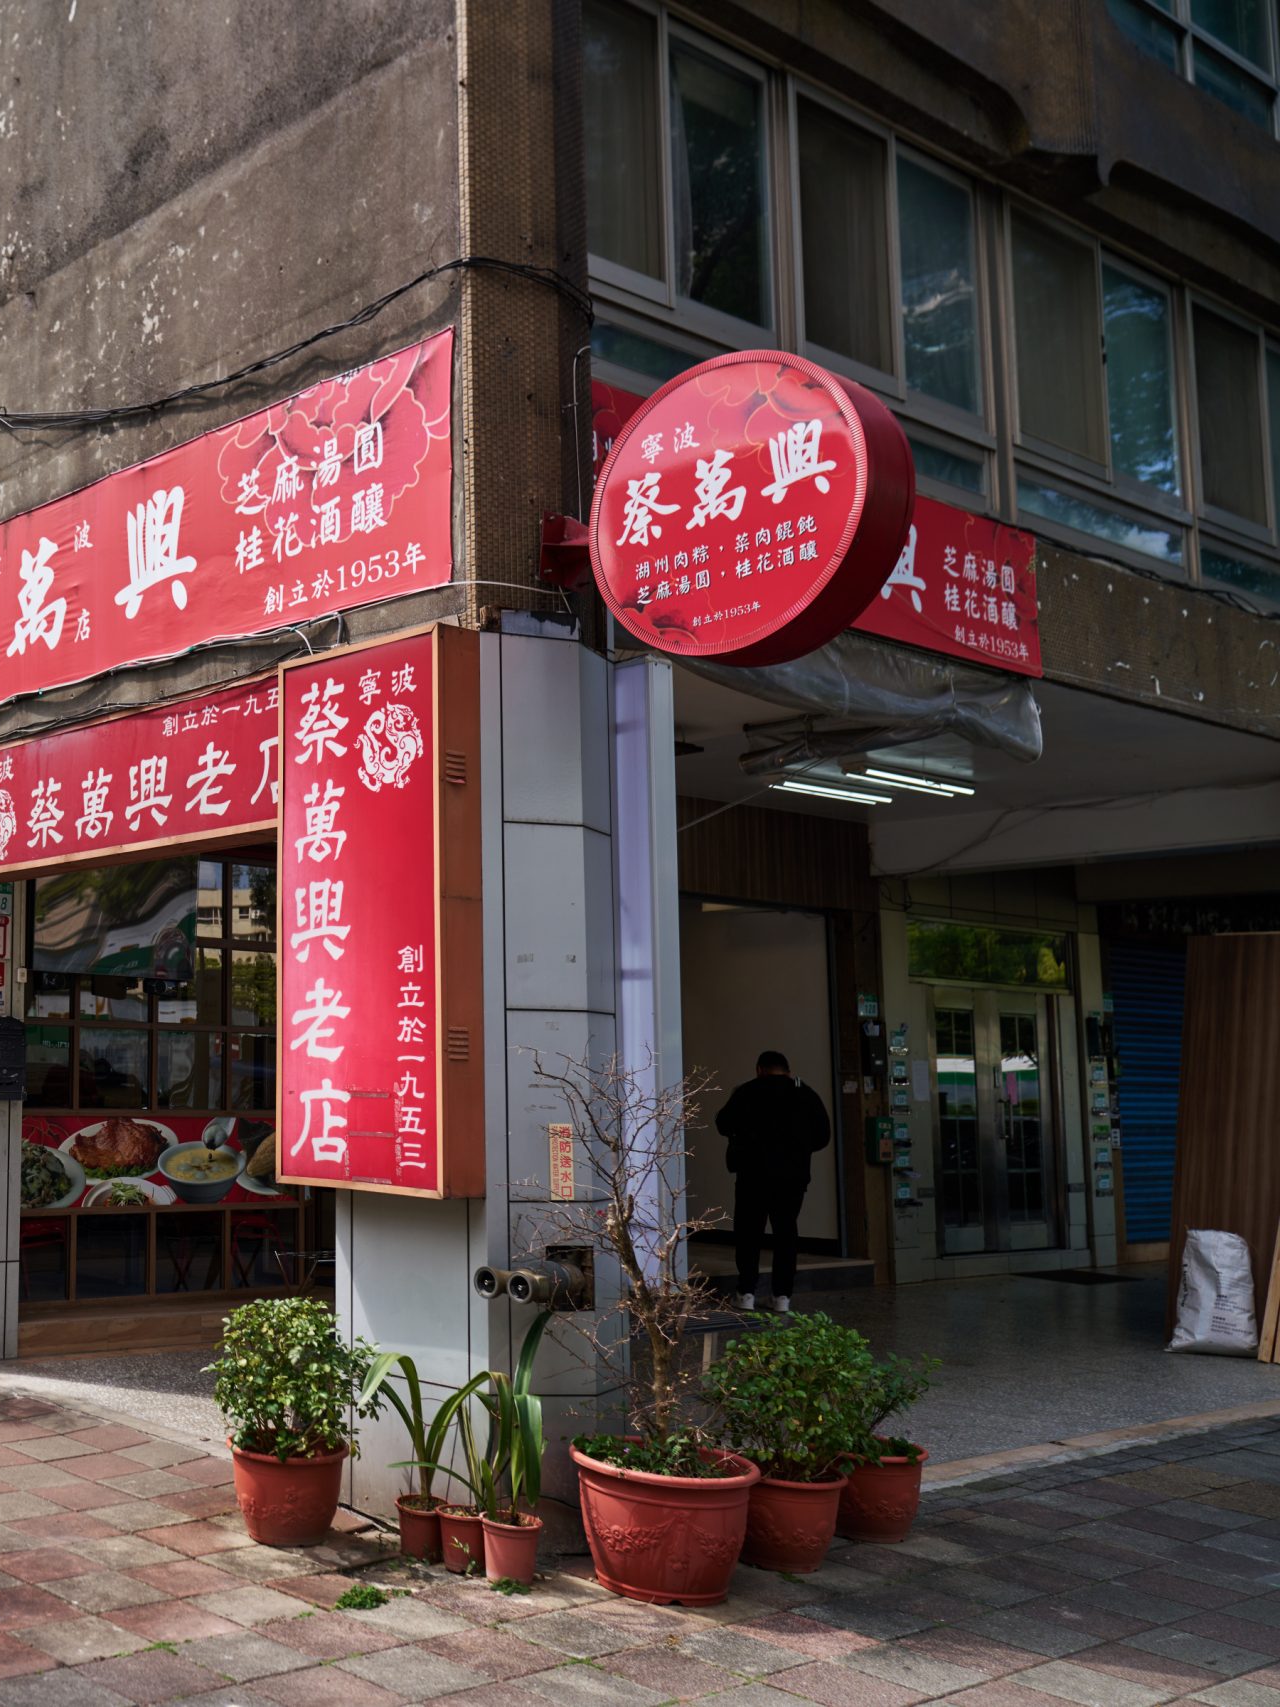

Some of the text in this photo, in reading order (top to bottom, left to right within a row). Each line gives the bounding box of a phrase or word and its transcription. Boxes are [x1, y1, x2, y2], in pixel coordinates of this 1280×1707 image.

[236, 422, 384, 516] 芝麻湯圓
[640, 421, 700, 465] 寧波
[616, 419, 837, 548] 蔡萬興
[235, 481, 385, 575] 桂花酒釀
[263, 541, 426, 616] 創立於1953年
[942, 545, 1016, 596] 芝麻湯圓
[692, 601, 762, 628] 創立於1953年
[943, 584, 1020, 632] 桂花酒釀
[954, 625, 1030, 661] 創立於1953年
[358, 663, 417, 706] 寧波
[290, 677, 352, 1165] 蔡萬興老店
[397, 945, 426, 1170] 創立於一九五三
